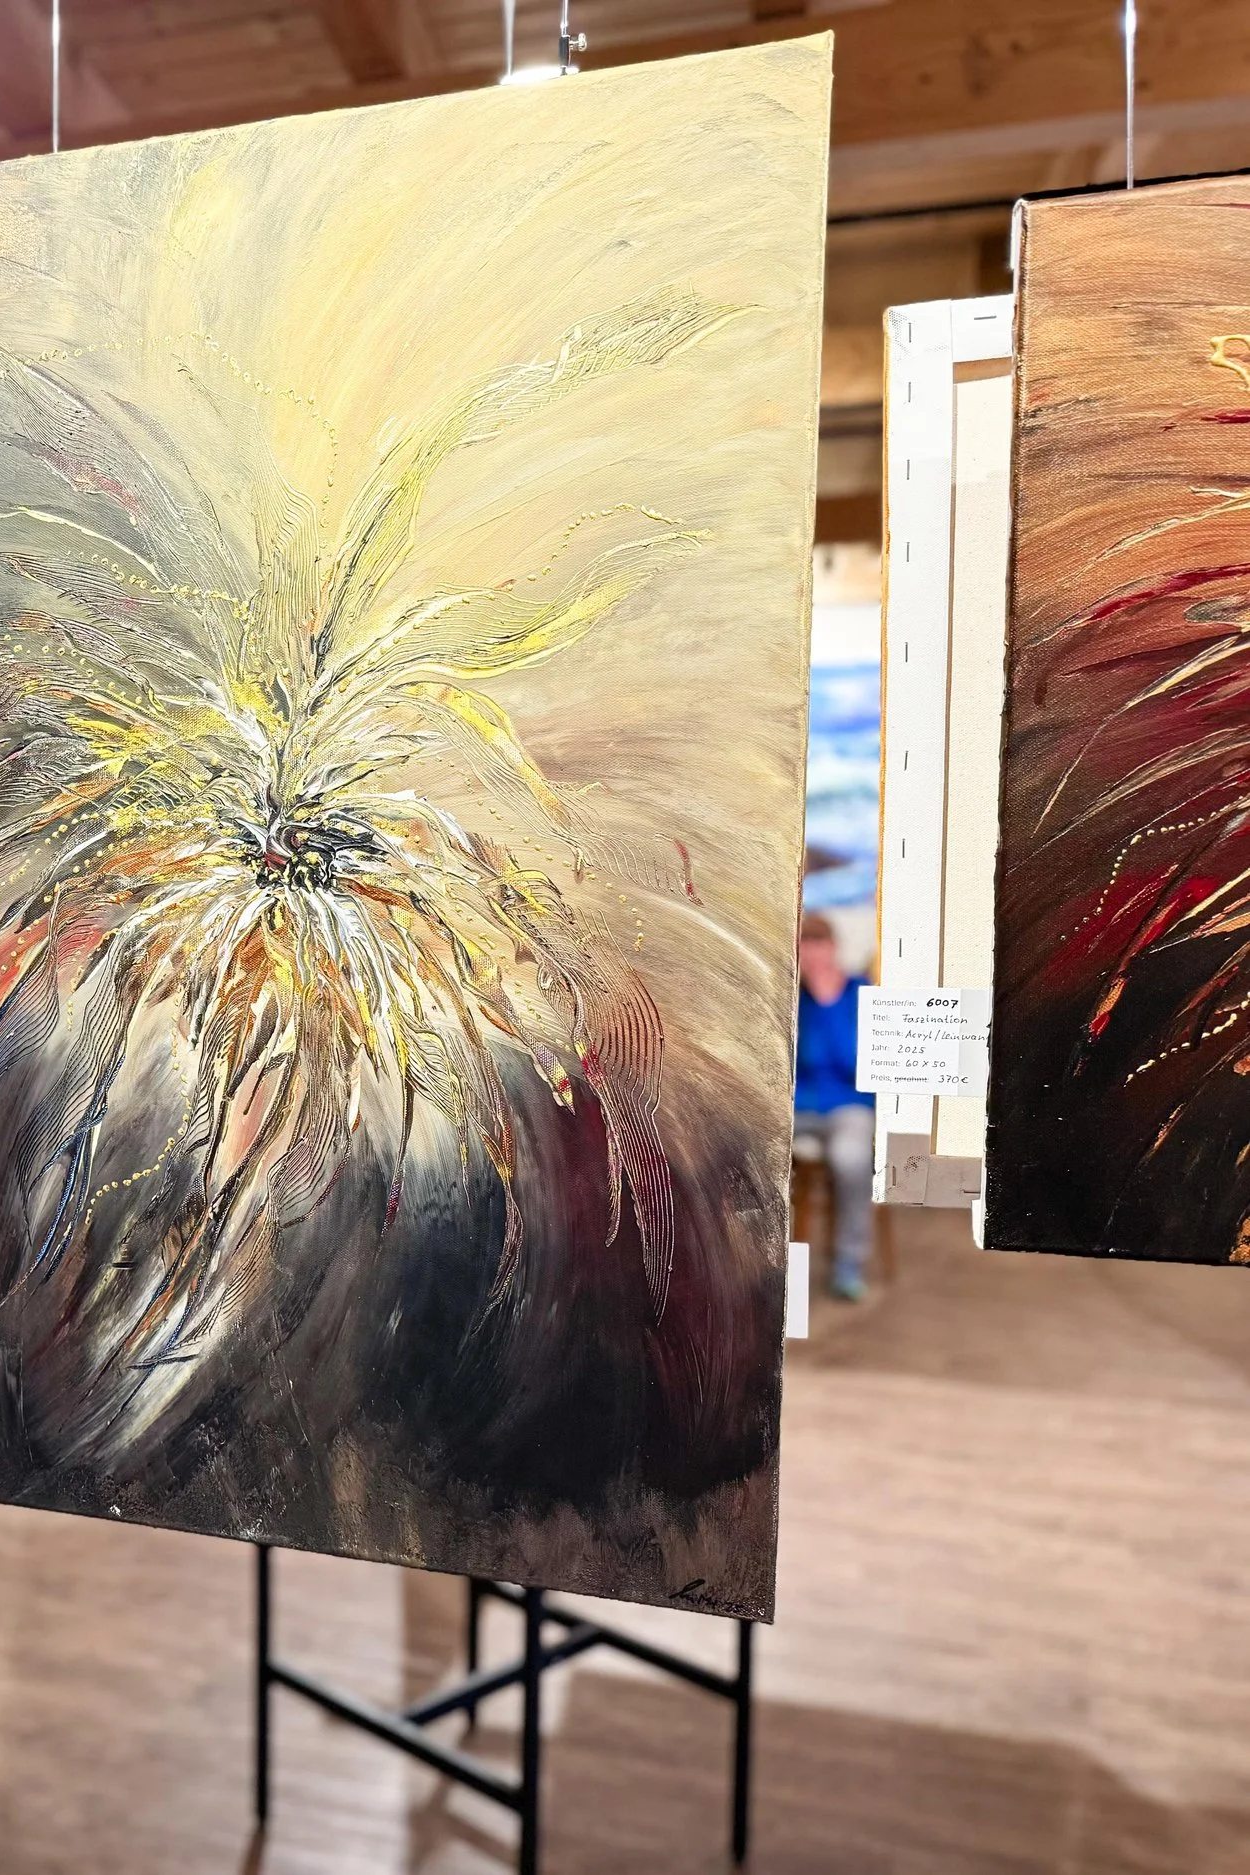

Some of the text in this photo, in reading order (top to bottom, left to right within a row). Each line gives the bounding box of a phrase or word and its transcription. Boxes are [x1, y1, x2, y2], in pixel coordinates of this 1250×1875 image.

[926, 998, 959, 1009] 6007
[902, 1013, 968, 1024] Faszination
[872, 1029, 903, 1037] Technik:
[897, 1045, 926, 1054] 2025
[870, 1059, 900, 1067] Format:
[938, 1075, 969, 1084] 370€
